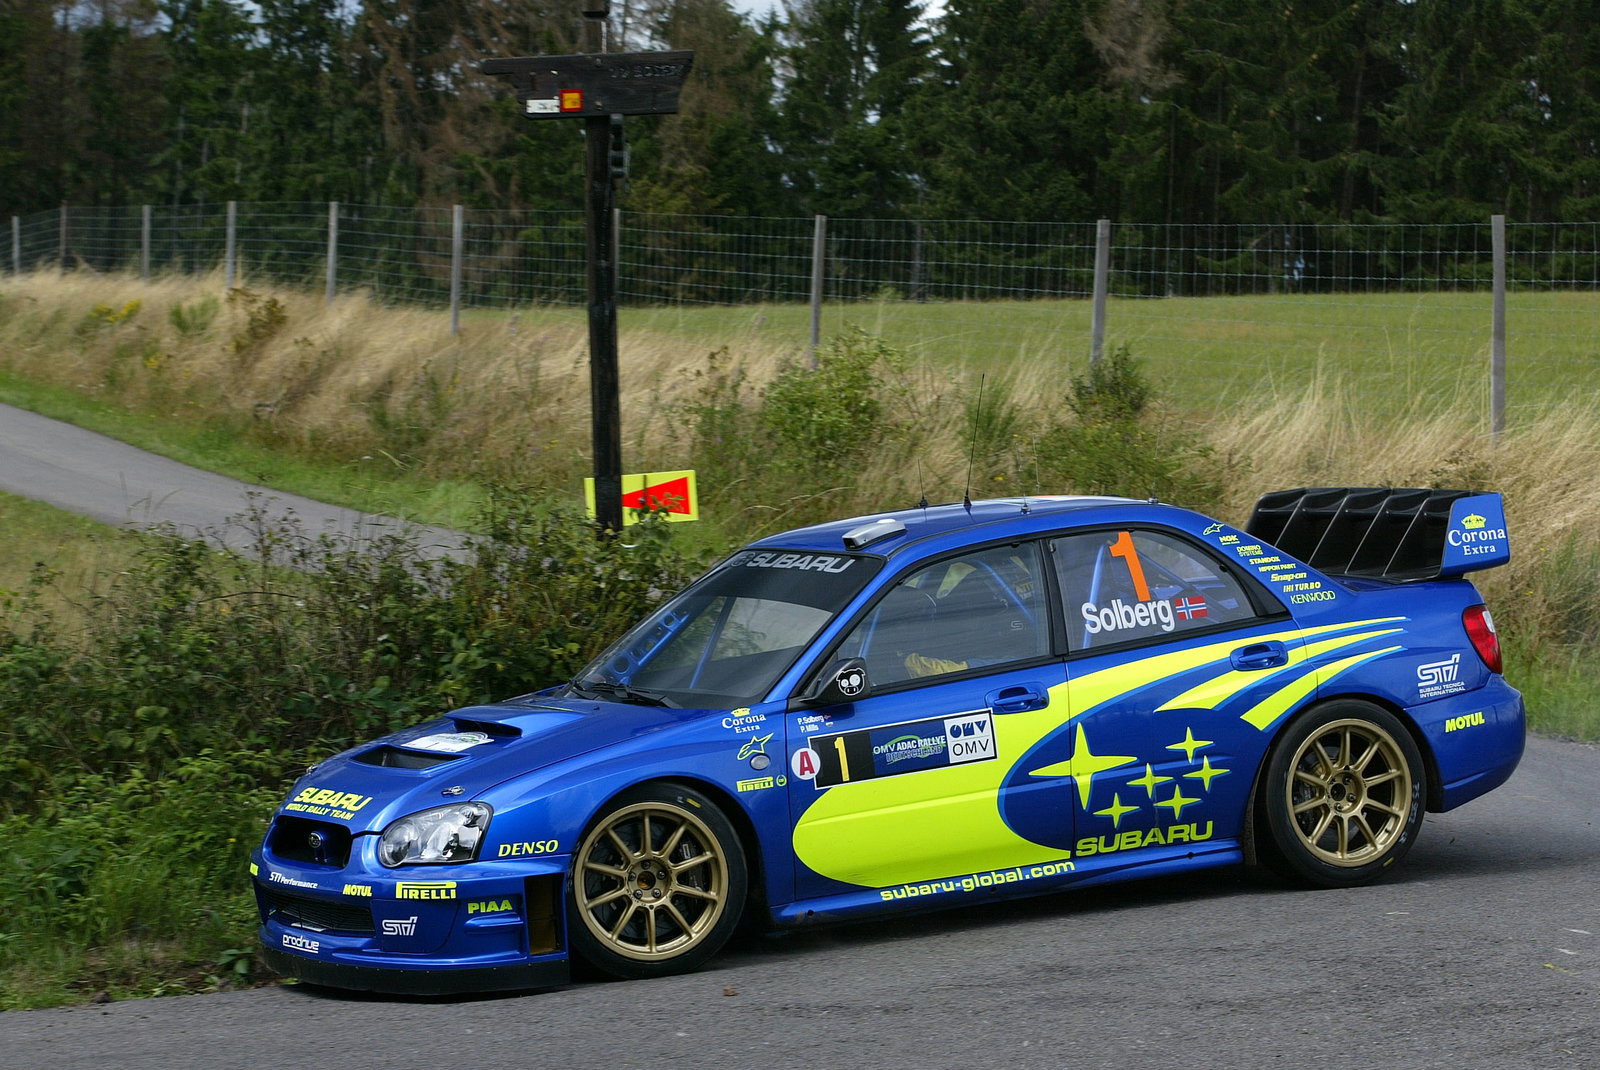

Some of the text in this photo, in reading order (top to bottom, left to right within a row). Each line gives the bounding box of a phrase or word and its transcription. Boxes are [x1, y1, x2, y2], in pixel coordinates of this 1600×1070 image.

[1448, 528, 1507, 546] Corona
[1463, 545, 1496, 556] Extra
[748, 553, 855, 573] SUBARU
[1109, 531, 1151, 602] 1
[1270, 572, 1307, 582] Snap-on
[1295, 581, 1321, 591] TURBO
[1290, 591, 1336, 604] KENWOOD
[1081, 599, 1175, 633] Solberg
[1419, 687, 1466, 698] INTERNATIONAL
[722, 713, 766, 729] Corona
[735, 724, 760, 734] Extra
[1445, 711, 1485, 733] MOTUL
[873, 735, 946, 754] OMV ADAC RALLYE
[952, 739, 989, 756] OMV
[800, 751, 815, 776] A
[834, 736, 850, 782] 1
[294, 787, 373, 811] SUBARU
[285, 803, 355, 820] WORLD RALLY TEAM
[1076, 821, 1214, 857] SUBARU
[498, 839, 559, 857] DENSO
[280, 876, 318, 889] Performance
[881, 860, 1075, 901] subaru-global.com
[342, 884, 372, 897] MOTUL
[396, 881, 457, 899] PIRELLI
[468, 899, 512, 914] PIAA
[283, 935, 319, 951] prodrive
